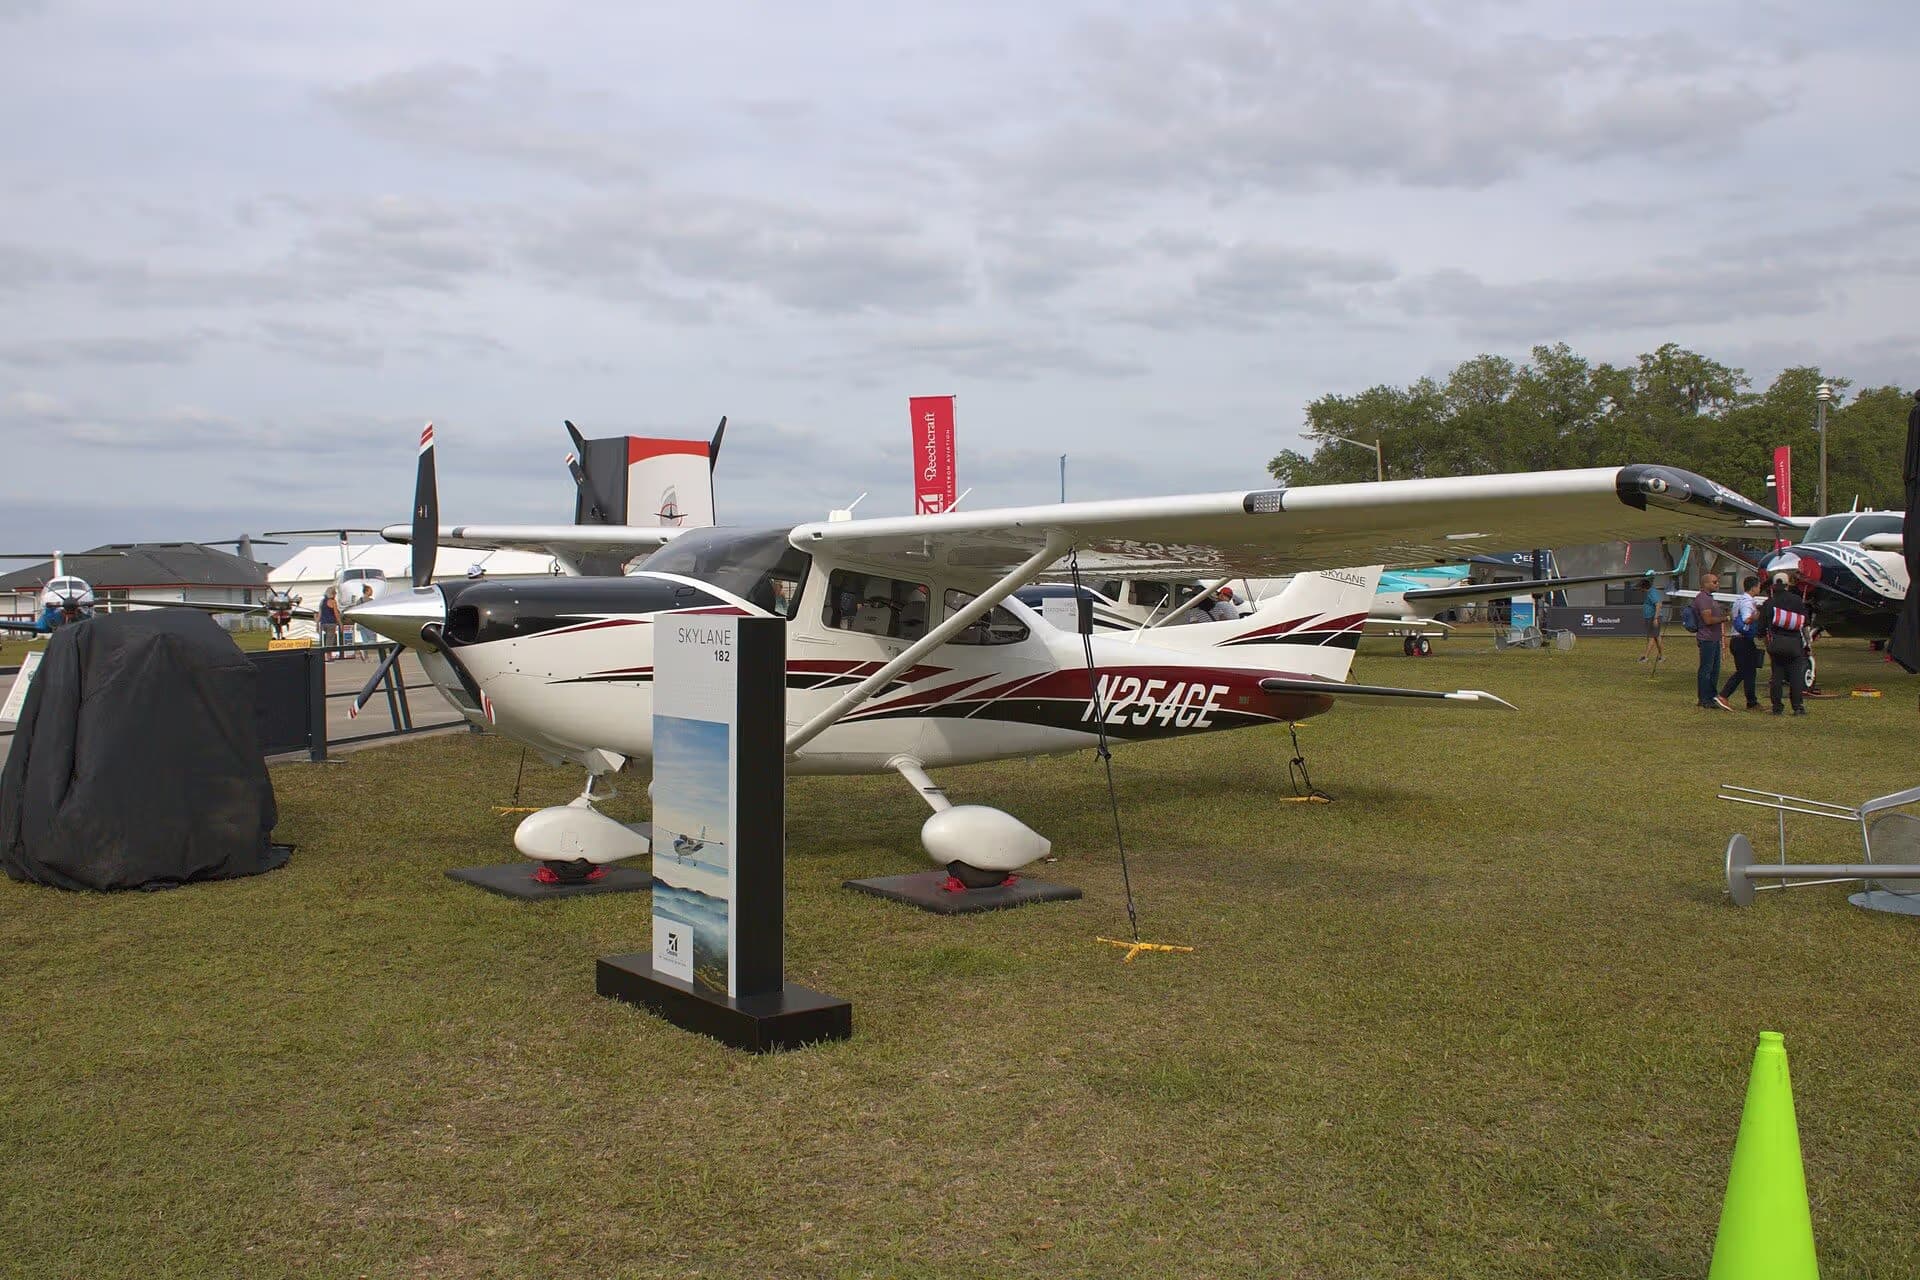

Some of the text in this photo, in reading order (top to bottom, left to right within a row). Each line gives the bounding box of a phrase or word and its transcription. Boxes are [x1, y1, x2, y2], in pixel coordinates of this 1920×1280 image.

[924, 412, 936, 481] Beechcraft
[678, 627, 731, 646] SKYLANE
[714, 649, 730, 662] 182
[1081, 674, 1230, 728] N254CE
